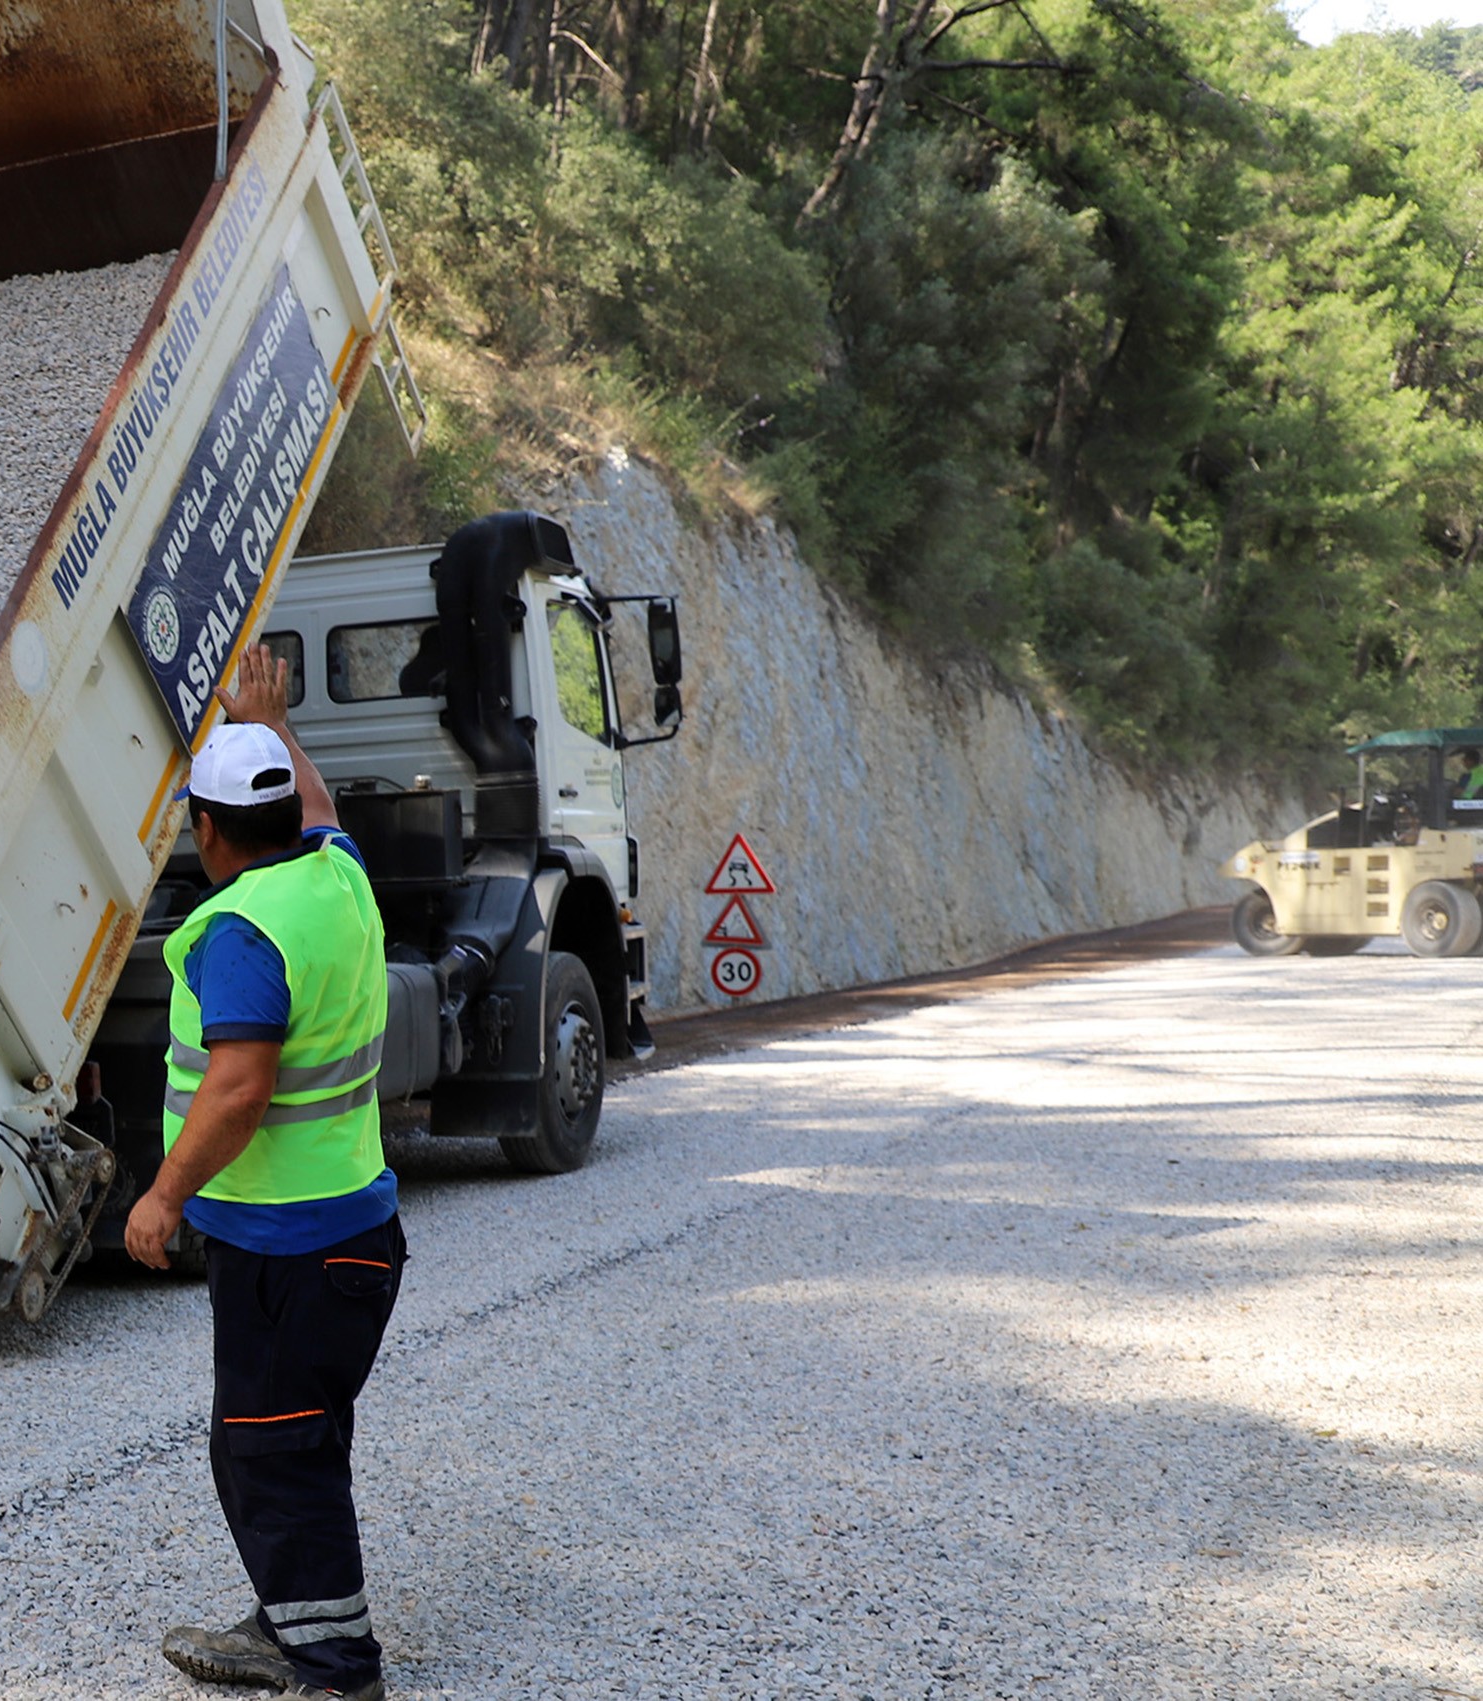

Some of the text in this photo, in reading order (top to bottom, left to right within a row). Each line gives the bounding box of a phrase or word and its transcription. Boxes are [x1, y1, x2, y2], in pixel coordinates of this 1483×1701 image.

[51, 479, 116, 610] MUĞLA
[107, 301, 201, 496] BÜYÜKŞEHİR
[193, 152, 268, 318] BELEDİYESİ
[162, 285, 297, 580] MUĞLA BÜYÜKŞEHİR
[208, 378, 287, 556] BELEDİYESİ
[177, 369, 332, 733] ASFALT ÇALIŞMASI
[722, 962, 752, 982] 30
